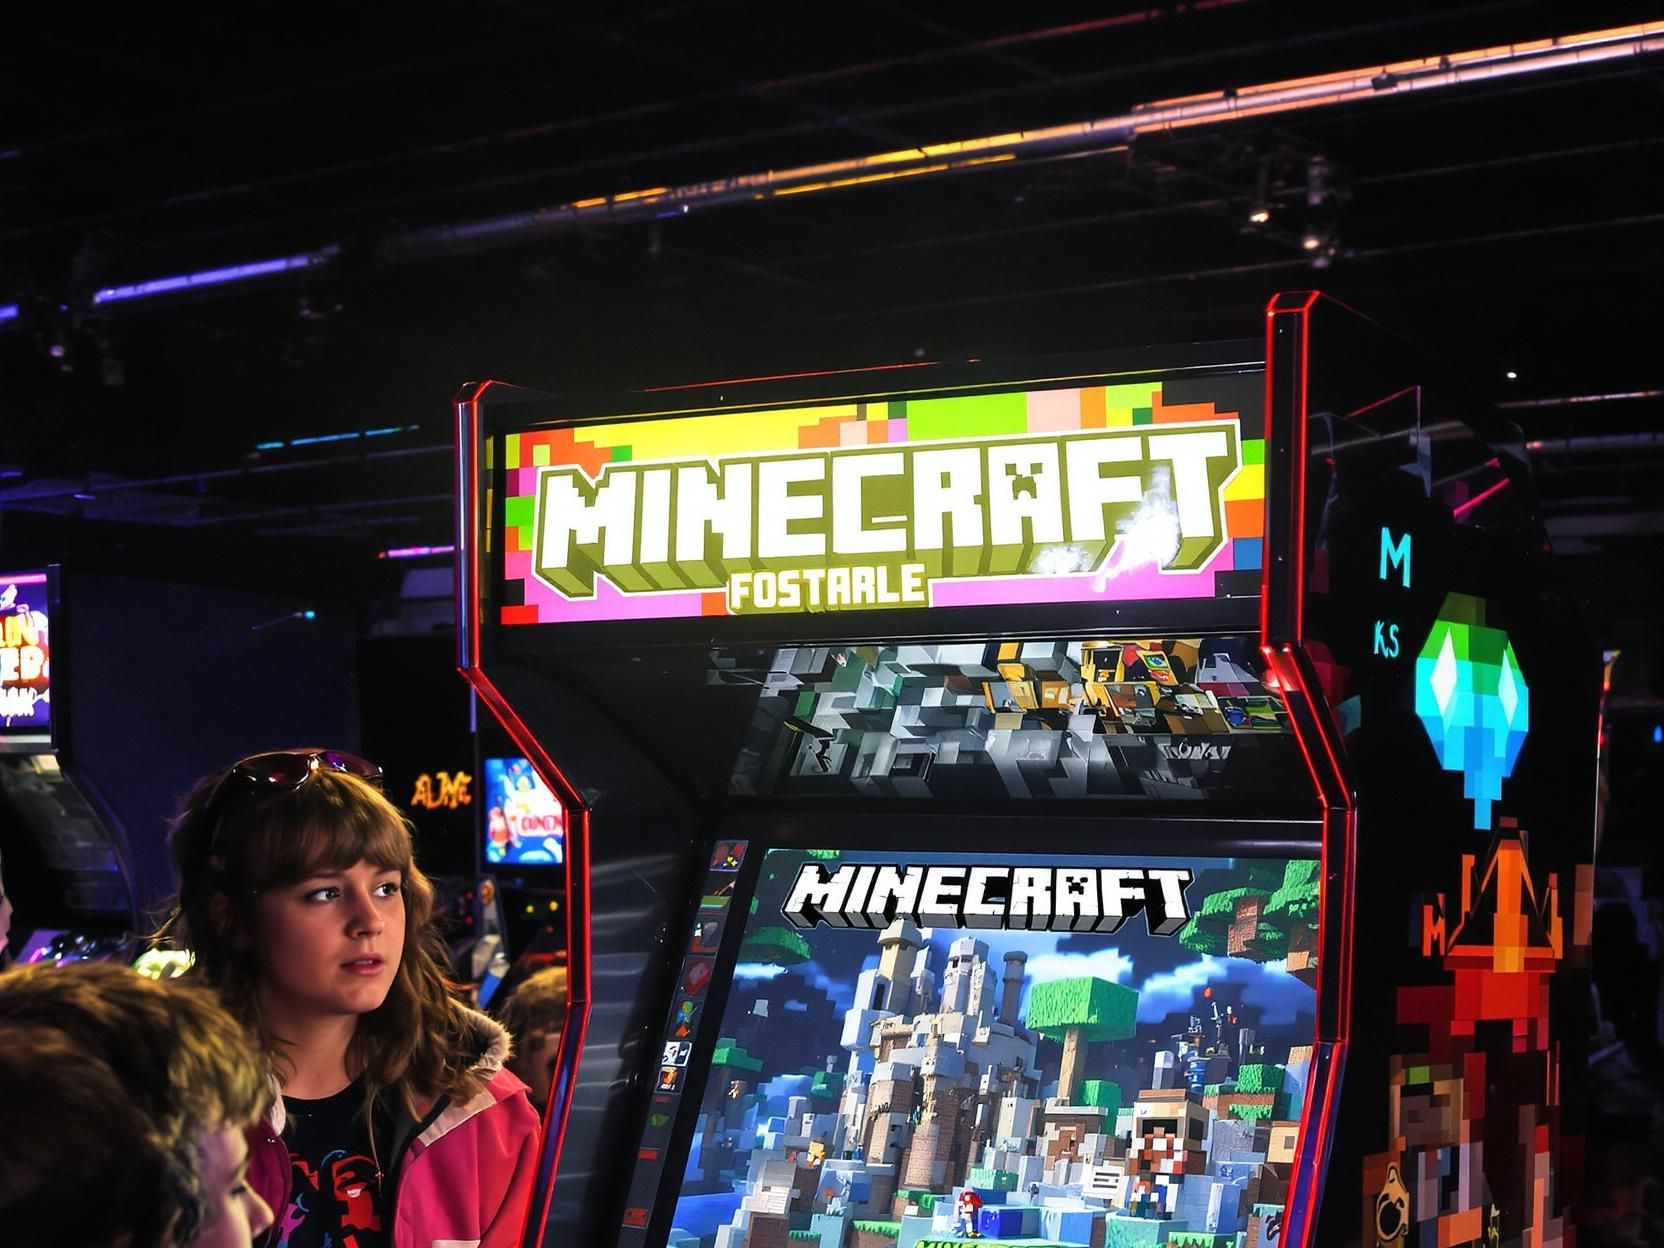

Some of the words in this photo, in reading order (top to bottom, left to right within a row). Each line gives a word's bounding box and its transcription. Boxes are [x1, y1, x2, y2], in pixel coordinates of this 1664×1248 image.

[537, 426, 1232, 594] MINECRAFT
[1379, 527, 1411, 588] M
[782, 863, 1192, 934] MINECRAFT
